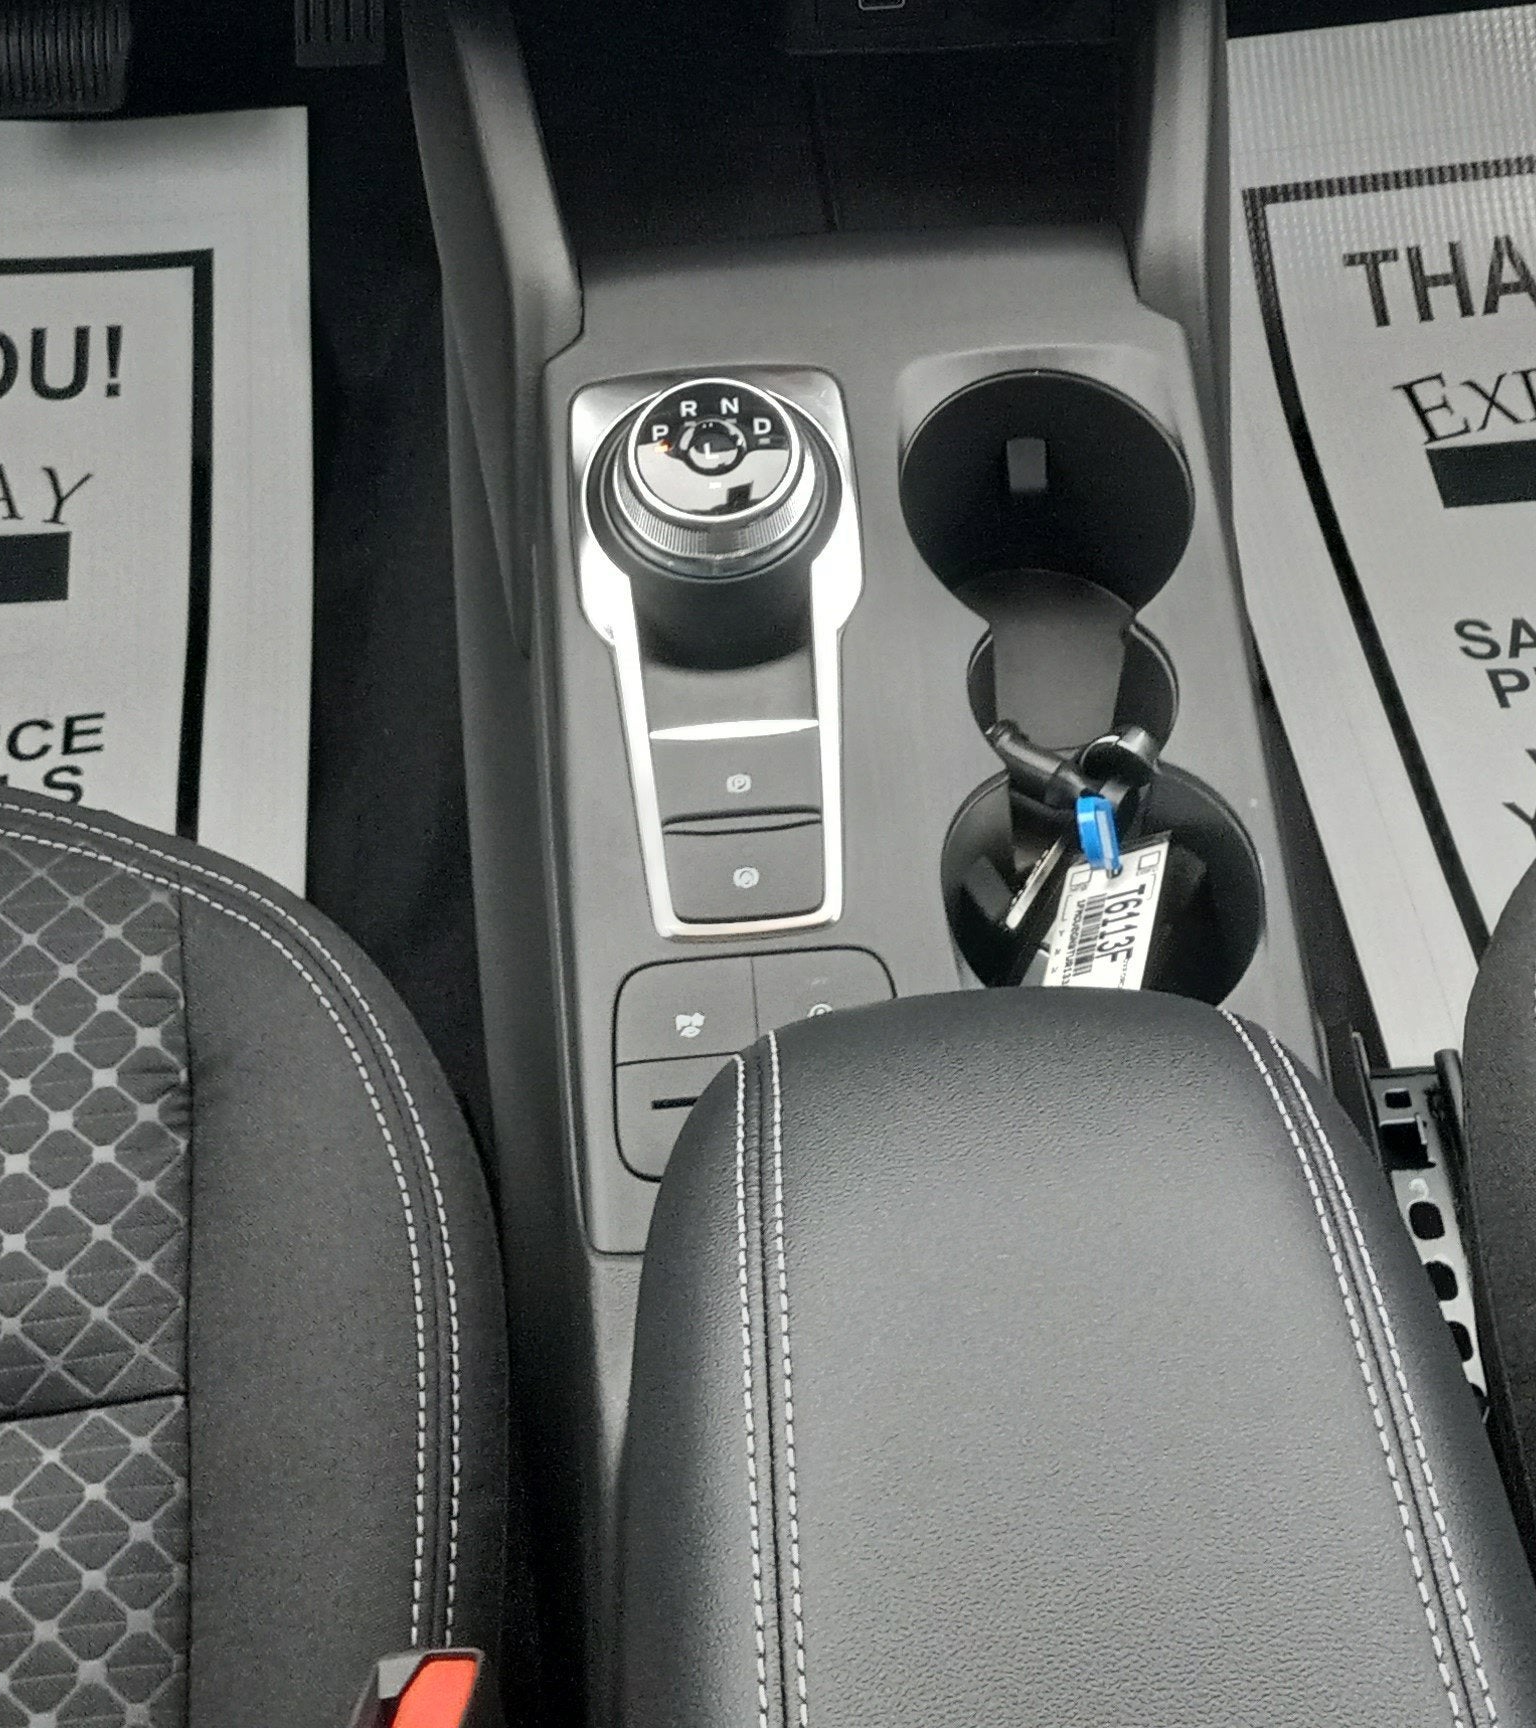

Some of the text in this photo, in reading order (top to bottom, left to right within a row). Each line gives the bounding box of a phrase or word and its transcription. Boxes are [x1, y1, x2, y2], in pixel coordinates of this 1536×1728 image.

[652, 396, 772, 441] P R N D
[1094, 883, 1146, 963] T6113F
